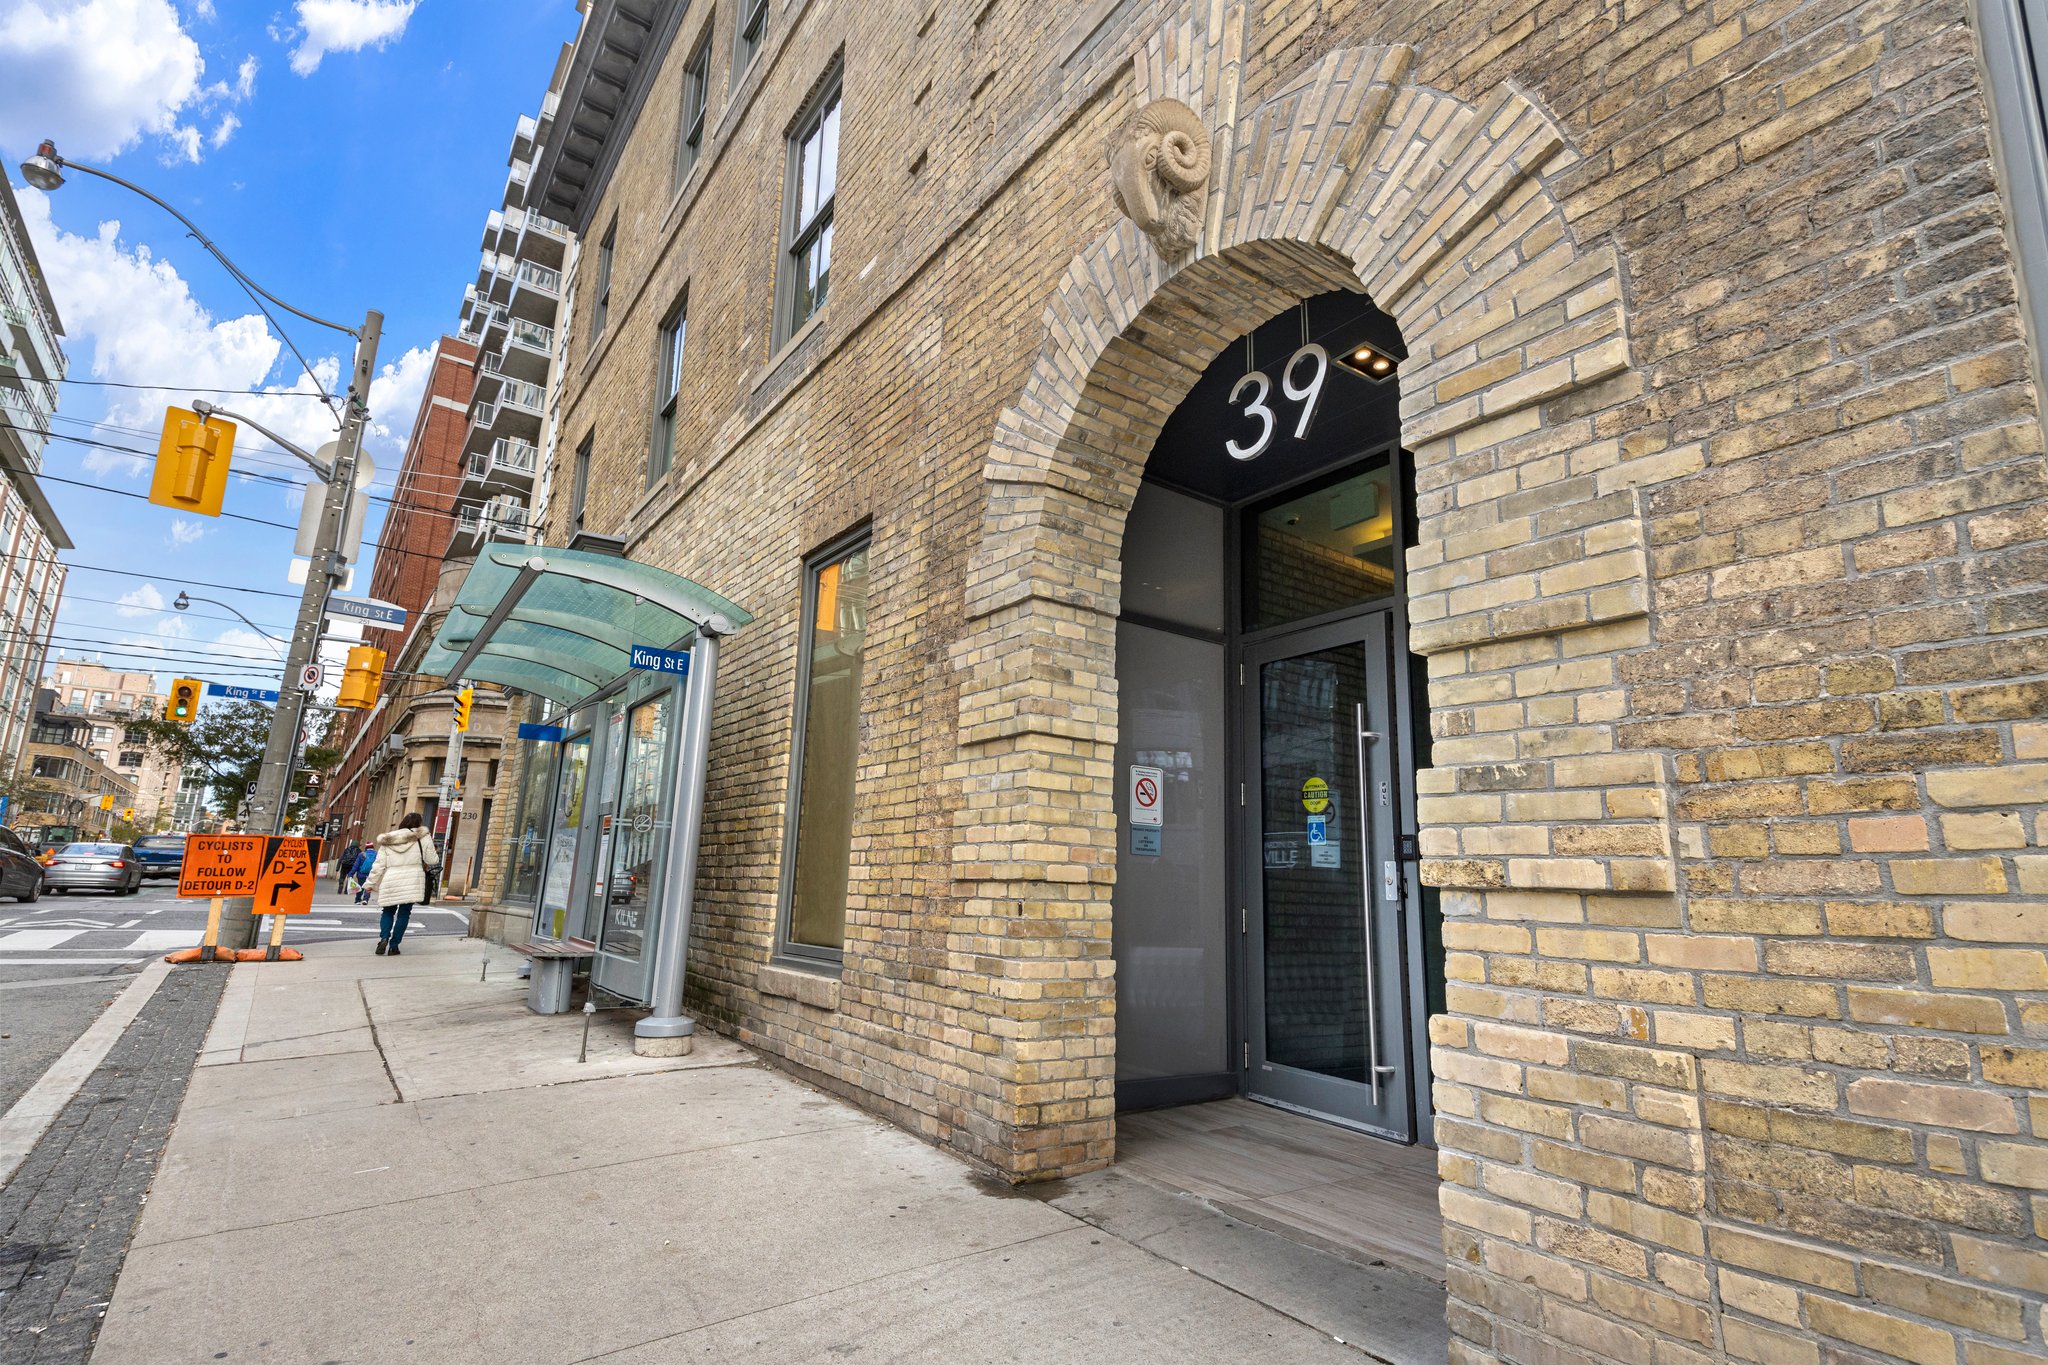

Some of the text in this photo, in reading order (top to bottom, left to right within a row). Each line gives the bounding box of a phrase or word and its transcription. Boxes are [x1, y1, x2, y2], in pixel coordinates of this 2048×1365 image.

[1225, 343, 1331, 462] 39
[343, 602, 370, 617] King
[374, 609, 384, 619] St
[386, 610, 394, 620] E
[633, 650, 684, 671] King St E
[225, 686, 249, 699] King
[259, 690, 267, 699] E
[1303, 791, 1328, 799] CAUTION
[461, 812, 478, 820] 230
[198, 841, 254, 851] CYCLISTS
[282, 838, 306, 848] CYCLIST
[217, 854, 232, 864] TO
[278, 849, 307, 859] DETOUR
[197, 867, 247, 877] FOLLOW
[272, 861, 307, 875] D-2
[184, 880, 255, 890] DETOUR D-2
